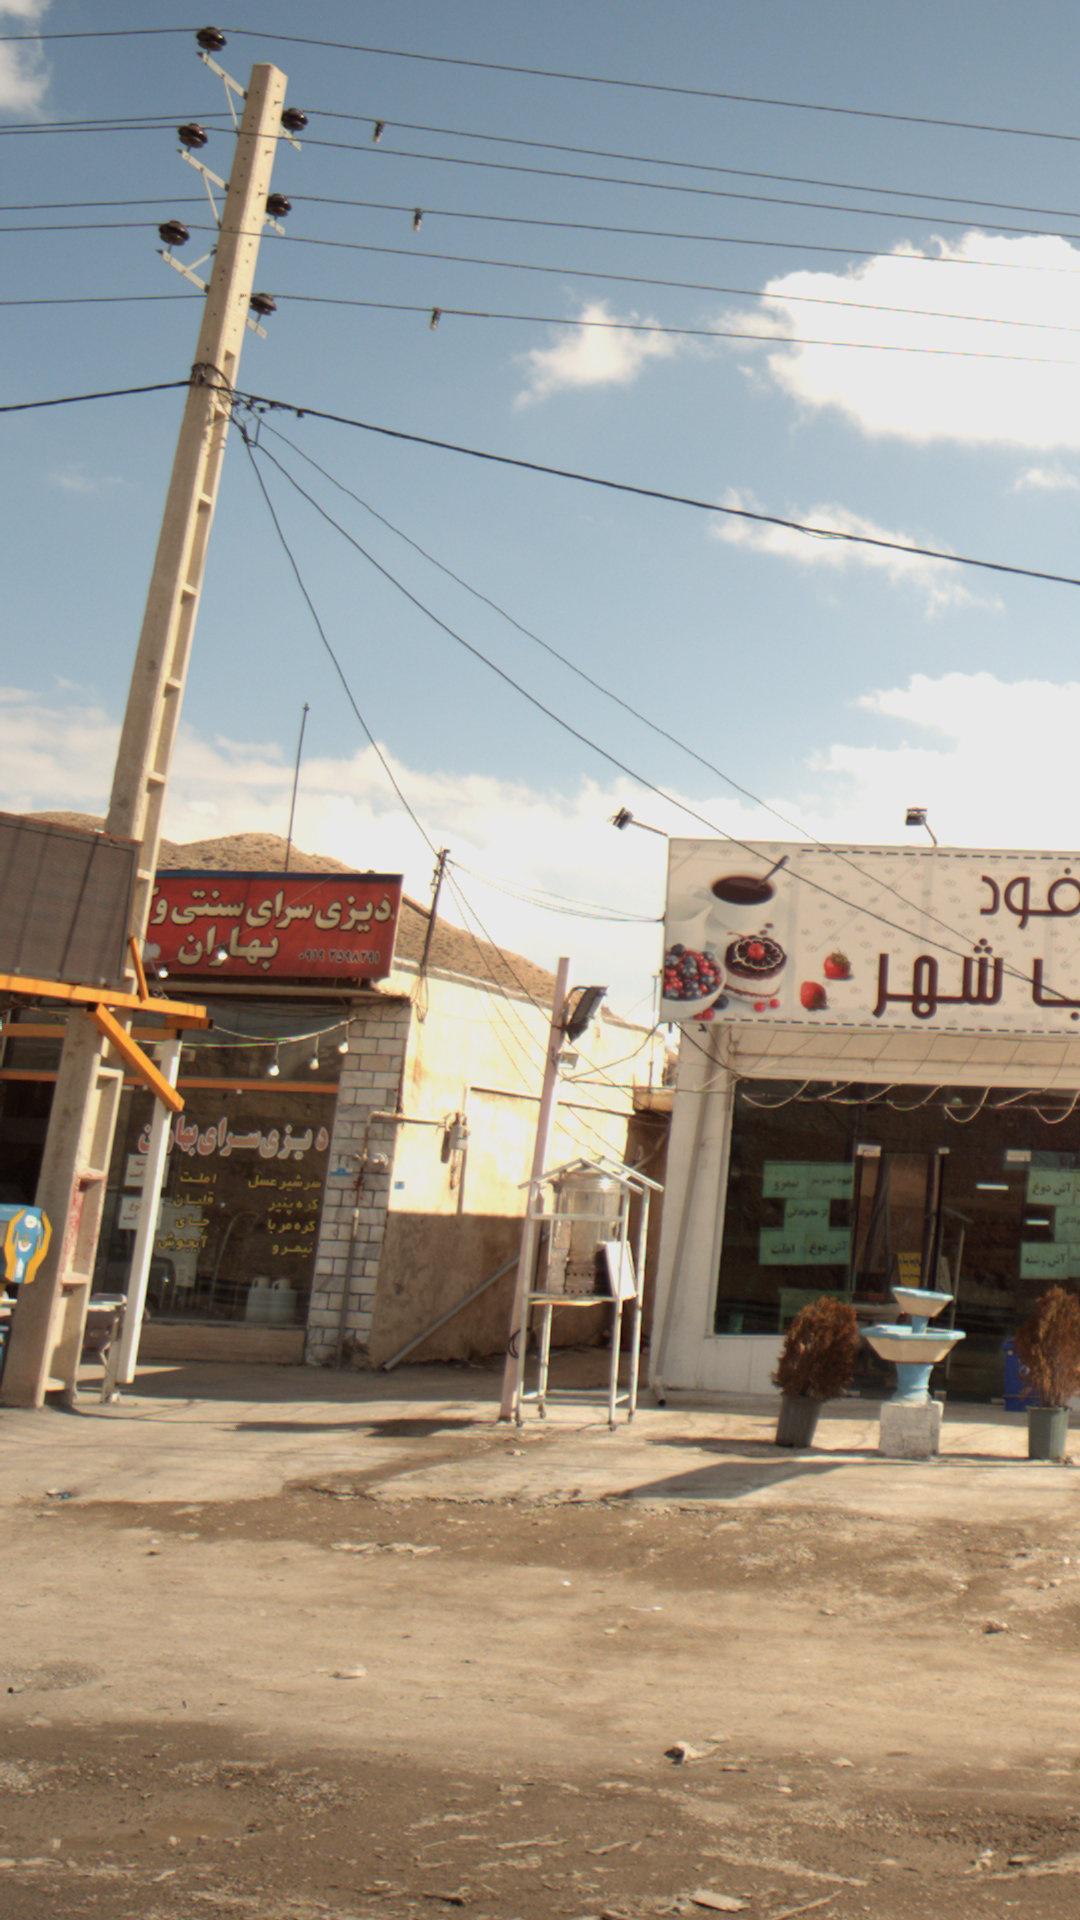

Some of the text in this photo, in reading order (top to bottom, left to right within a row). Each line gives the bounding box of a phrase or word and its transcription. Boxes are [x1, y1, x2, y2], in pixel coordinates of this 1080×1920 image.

[170, 888, 245, 925] سنتی
[245, 890, 315, 930] سرای
[314, 894, 393, 932] دیزی
[177, 925, 280, 971] بهاران
[873, 937, 1003, 1020] شهر
[197, 1116, 262, 1157] سرای
[258, 1124, 330, 1161] دیزی
[172, 1191, 215, 1208] قلیان
[175, 1213, 210, 1233] چای
